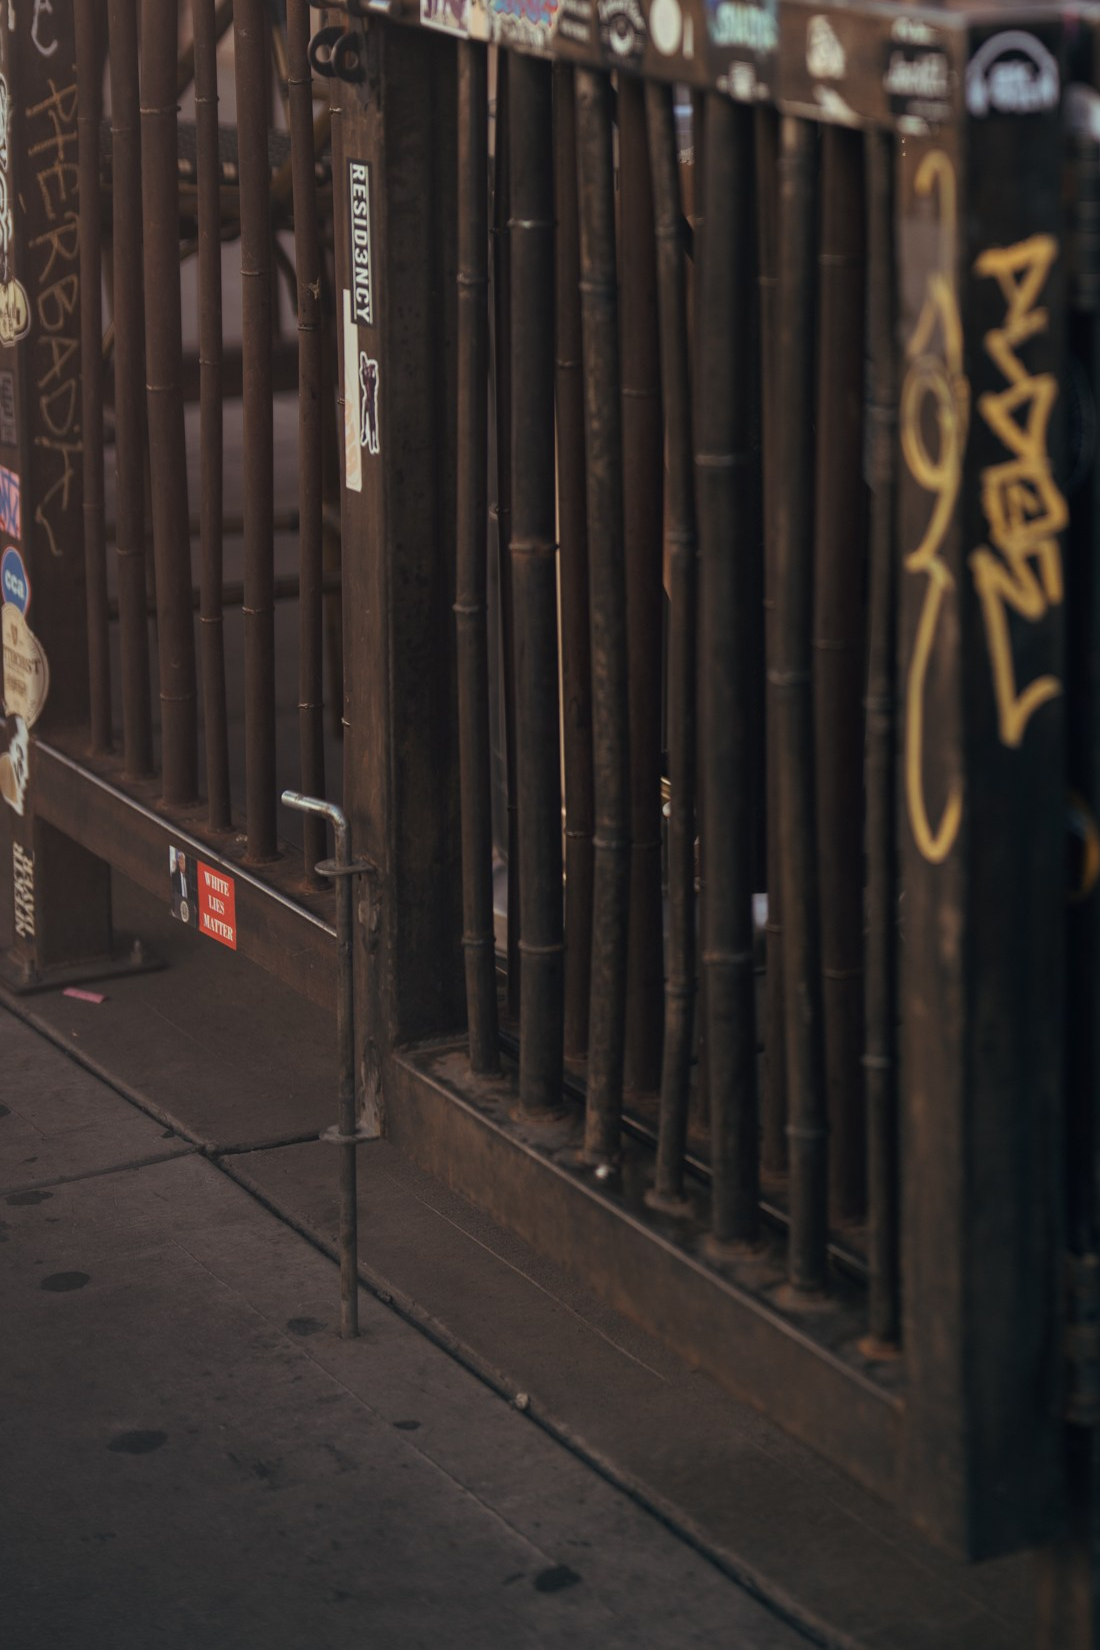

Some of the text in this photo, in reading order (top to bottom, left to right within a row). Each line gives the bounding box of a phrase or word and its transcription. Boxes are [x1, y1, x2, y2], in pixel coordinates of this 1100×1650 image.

[4, 568, 25, 600] cca
[203, 870, 230, 897] WHITE
[207, 894, 225, 916] LIES
[203, 912, 233, 942] MATTER
